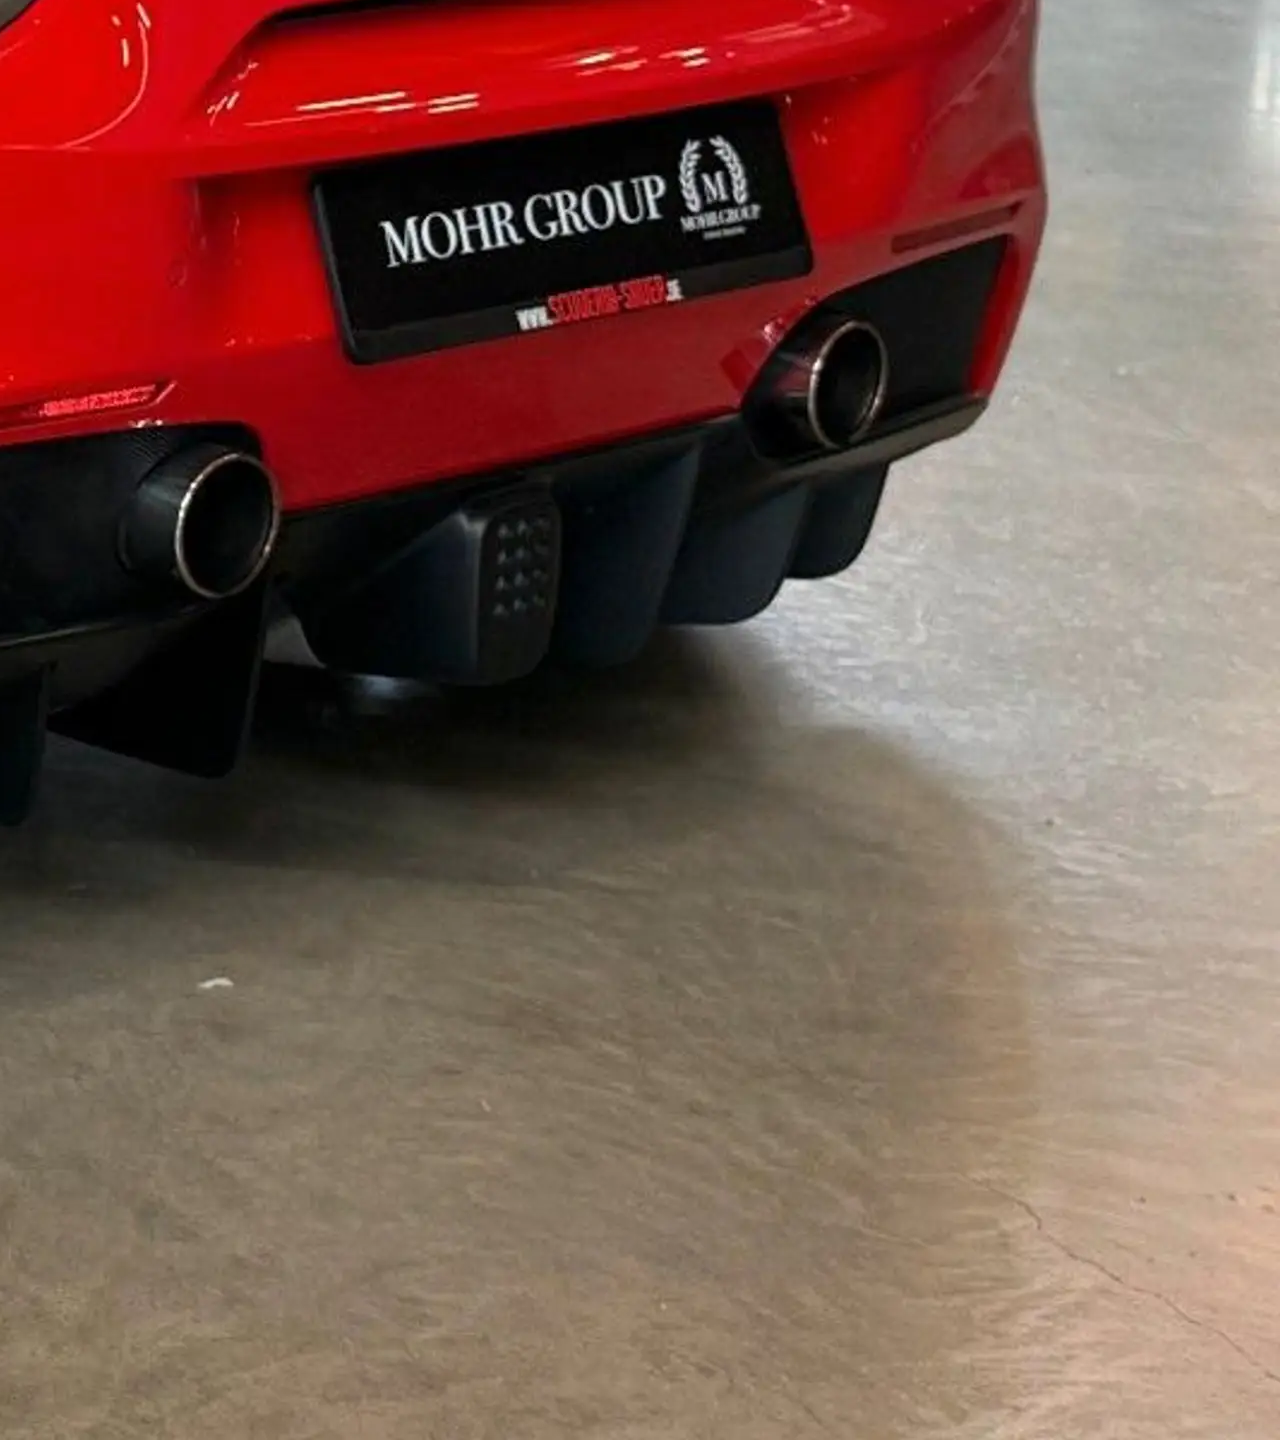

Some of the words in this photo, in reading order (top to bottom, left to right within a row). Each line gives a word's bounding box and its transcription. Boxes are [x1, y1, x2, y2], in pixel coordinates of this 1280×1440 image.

[701, 170, 729, 205] M
[379, 200, 524, 268] MOHR
[523, 174, 667, 242] GROUP
